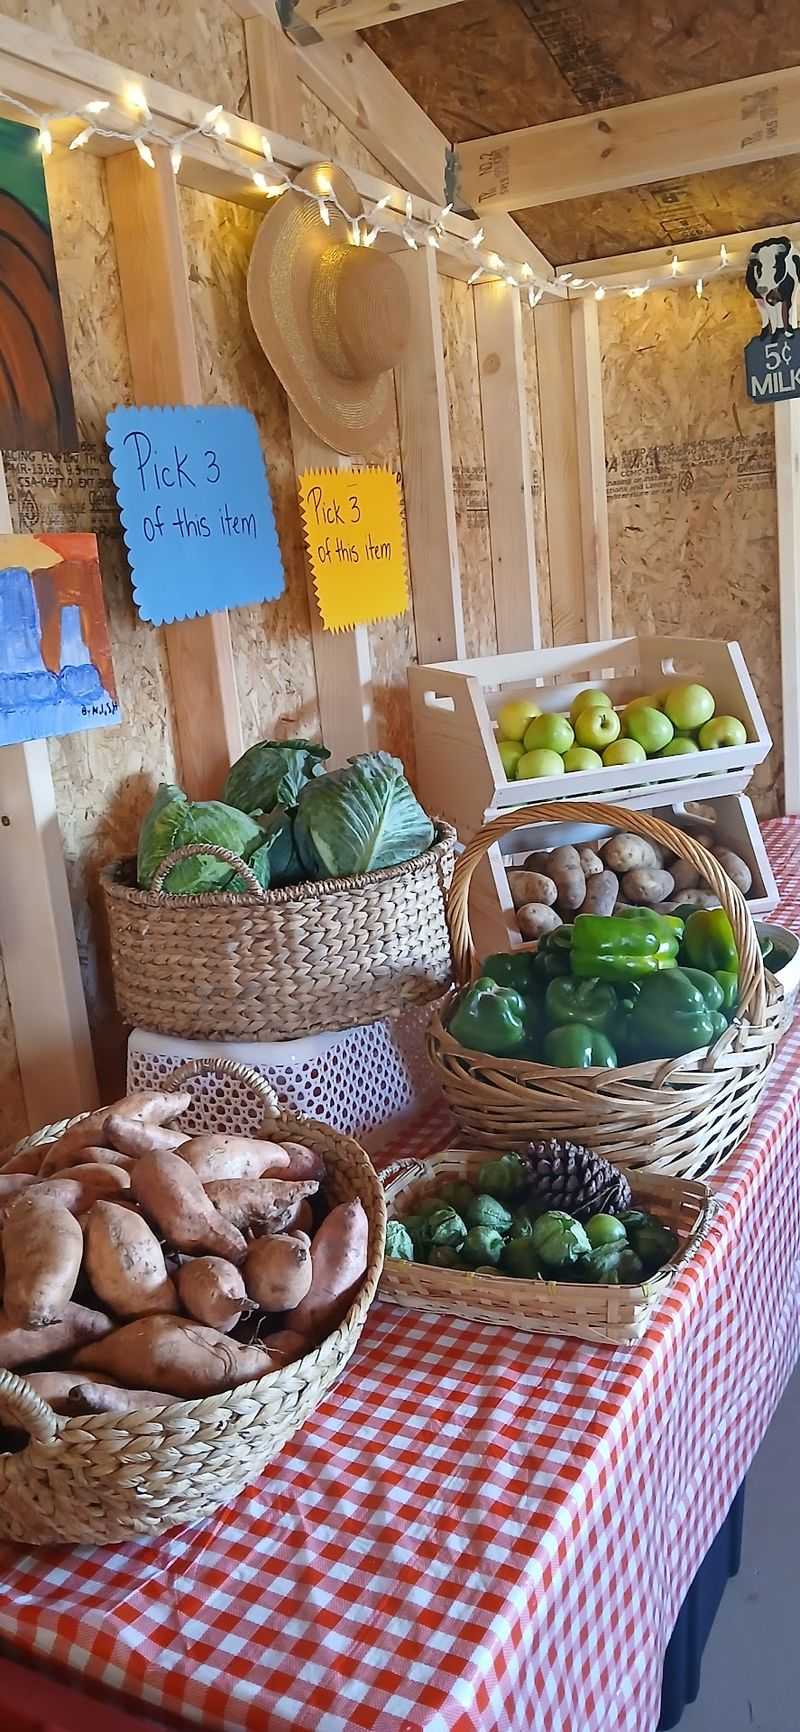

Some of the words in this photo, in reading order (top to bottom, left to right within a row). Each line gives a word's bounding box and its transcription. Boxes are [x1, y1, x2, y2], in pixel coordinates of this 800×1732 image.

[765, 341, 792, 370] 5¢
[751, 368, 800, 397] MILK
[123, 431, 196, 491] Pick
[204, 451, 220, 483] 3
[143, 506, 164, 542] of
[172, 507, 211, 537] this
[219, 503, 257, 539] item
[307, 486, 345, 525] Pick
[349, 496, 361, 523] 3
[317, 537, 333, 563] of
[335, 537, 359, 562] this
[364, 532, 391, 560] item
